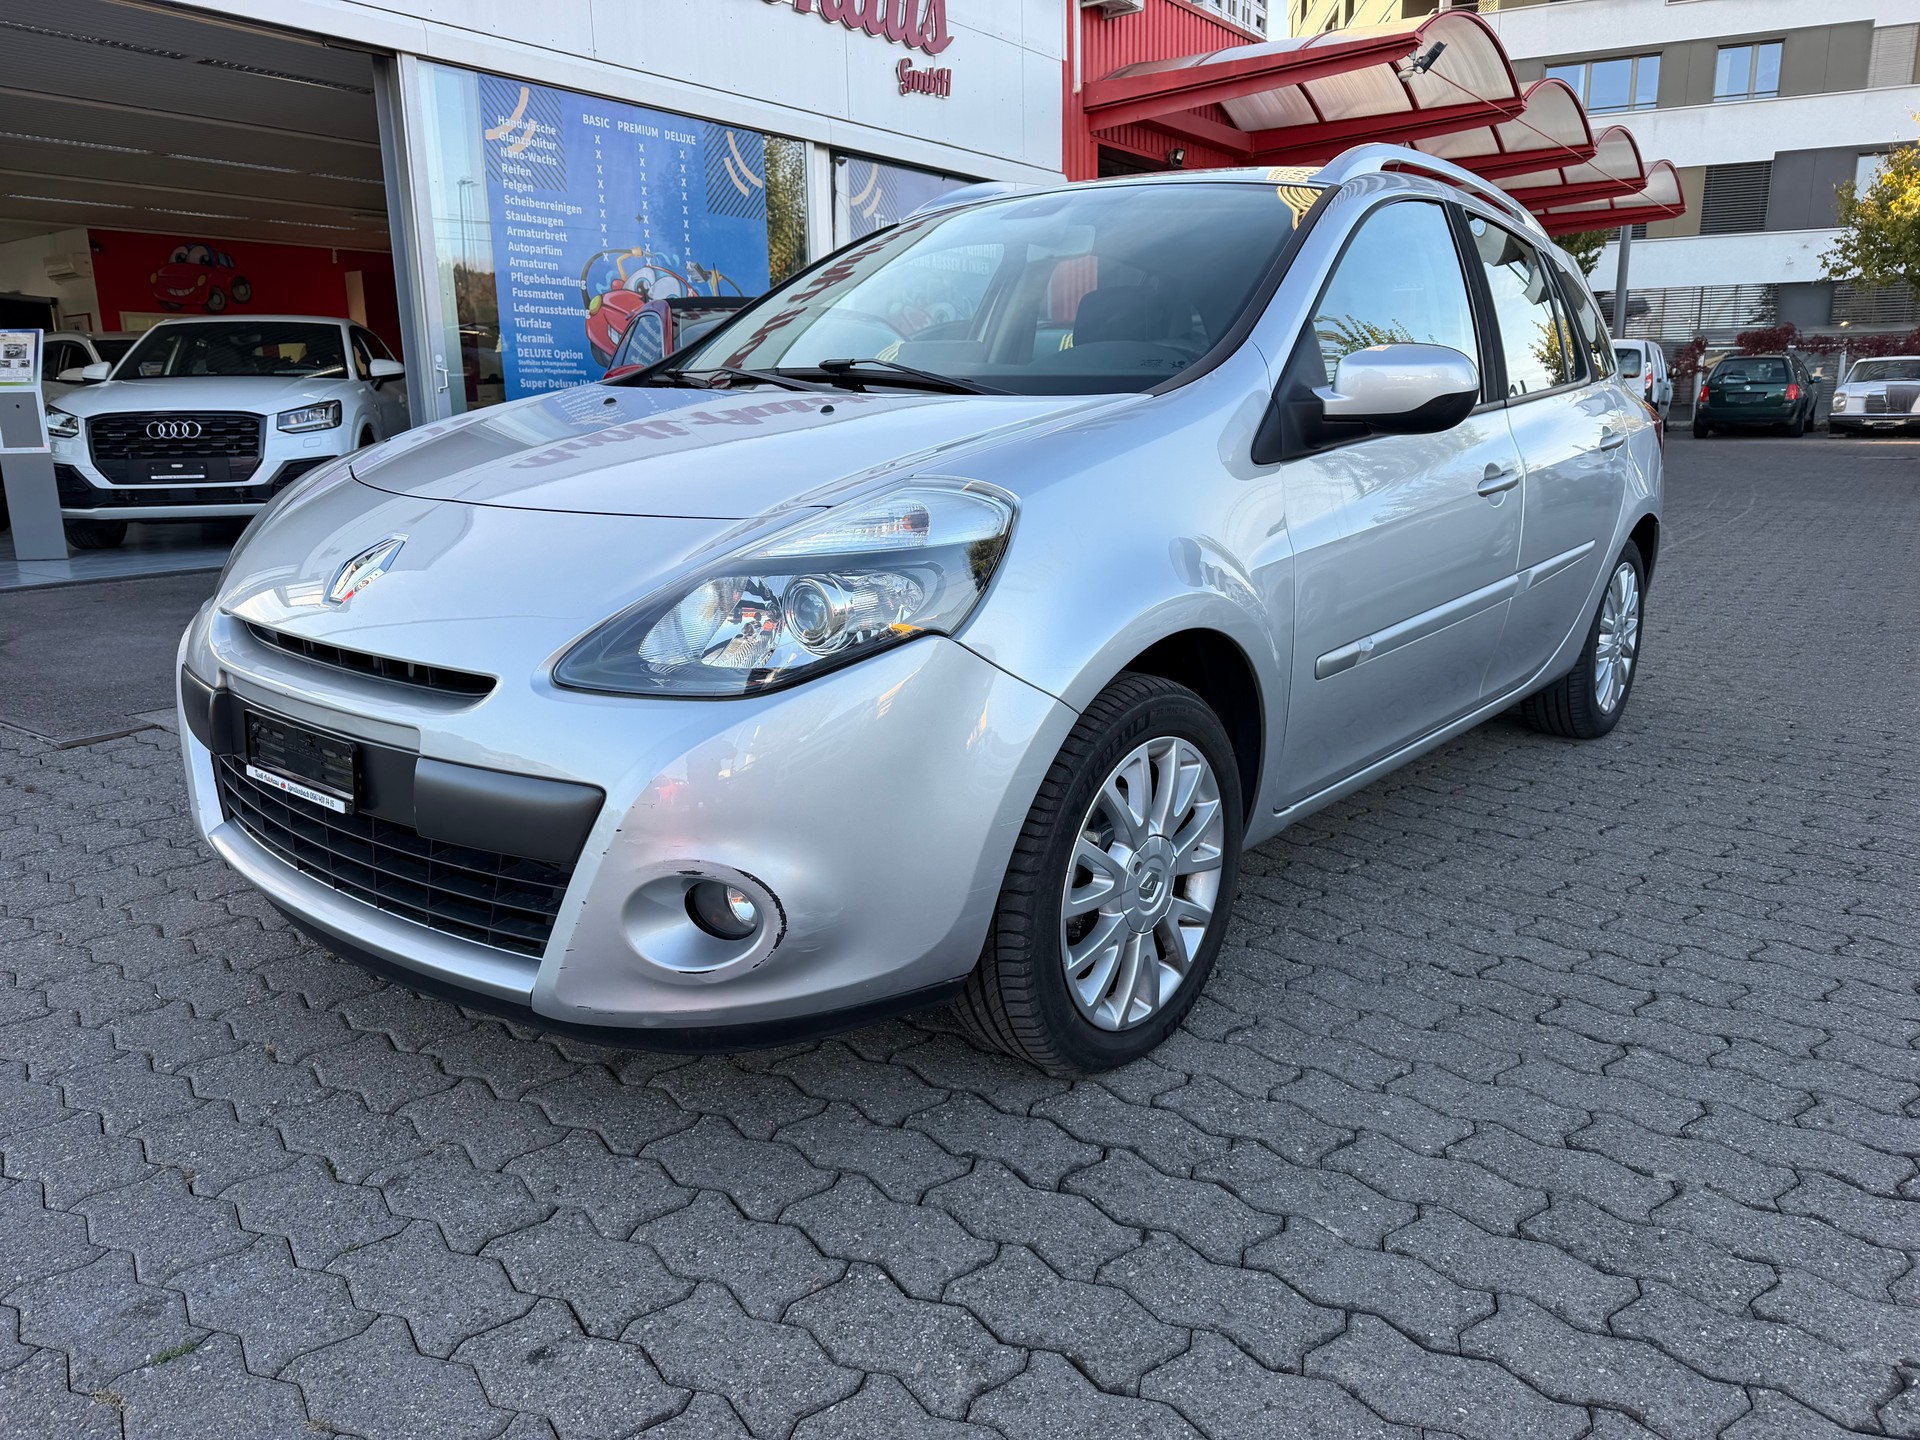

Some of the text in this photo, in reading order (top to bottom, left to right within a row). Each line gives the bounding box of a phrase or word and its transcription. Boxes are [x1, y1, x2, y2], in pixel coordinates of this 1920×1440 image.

[896, 57, 952, 98] GmbH
[497, 115, 556, 136] Handwäsche
[582, 113, 696, 145] BASIC PREMIUM DELUXE
[499, 132, 557, 151] Glanzpolitur
[500, 147, 557, 166] Nano-Wachs
[502, 163, 532, 177] Reifen
[503, 179, 534, 193] Felgen
[504, 194, 582, 215] Scheibenreinigen
[505, 210, 564, 227] Staubsaugen
[506, 225, 568, 242] Armaturbrett
[508, 241, 563, 256] Autoparfüm
[509, 256, 558, 271] Armaturen
[511, 272, 587, 290] Pflgebehandlung
[512, 287, 564, 300] Fussmatten
[513, 303, 591, 319] Lederausstattung
[514, 317, 552, 329] Türfalze
[516, 332, 554, 344] Keramik
[517, 348, 584, 361] DELUXE Option
[520, 378, 547, 390] Super
[548, 379, 579, 388] Deluxe
